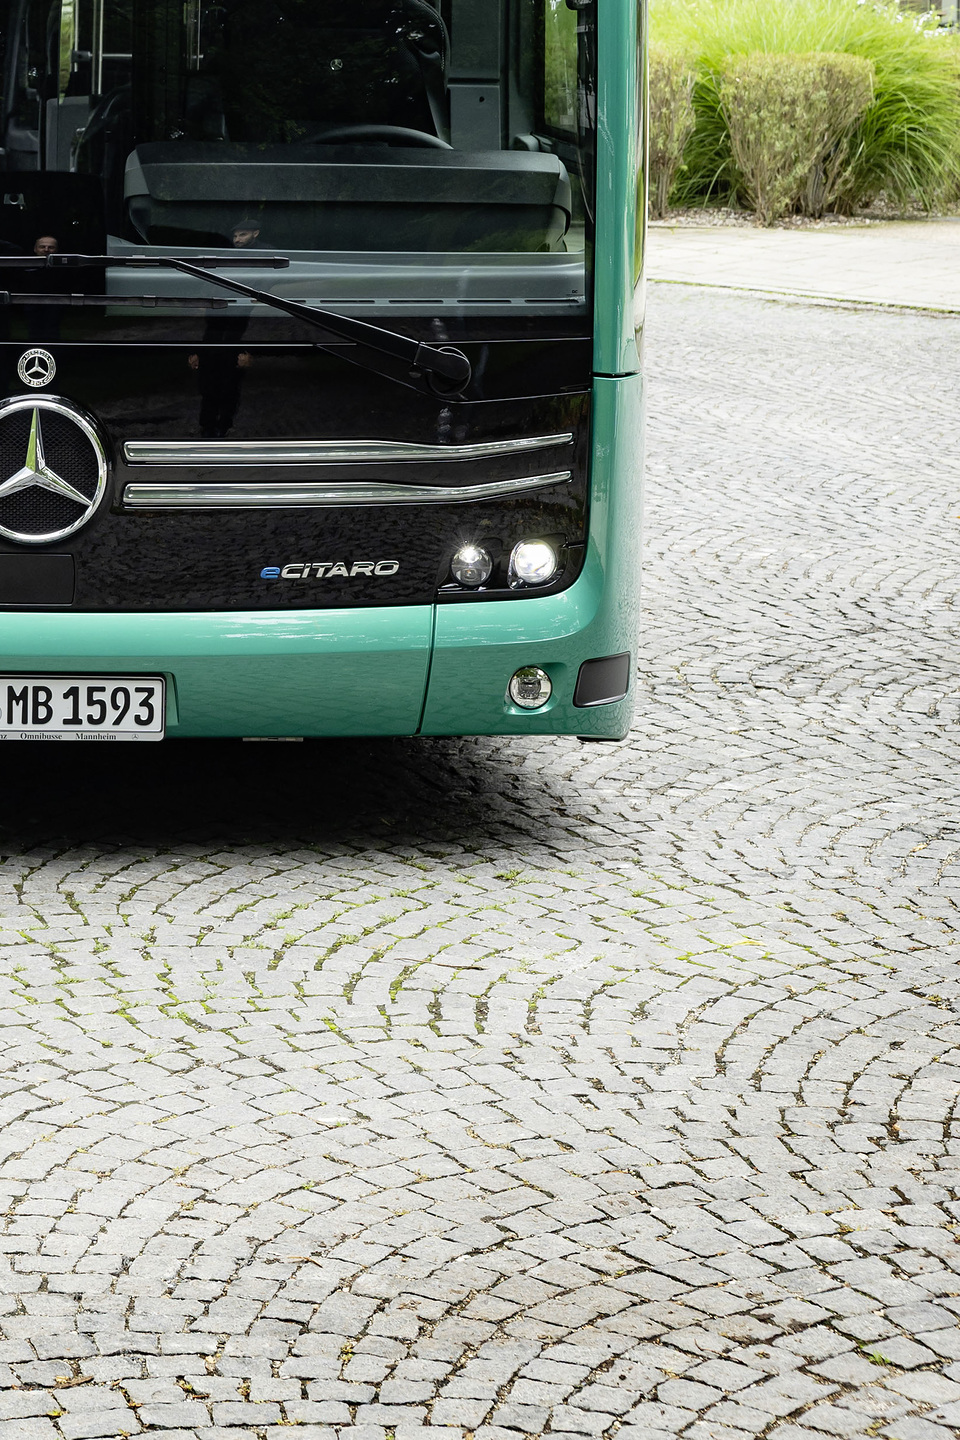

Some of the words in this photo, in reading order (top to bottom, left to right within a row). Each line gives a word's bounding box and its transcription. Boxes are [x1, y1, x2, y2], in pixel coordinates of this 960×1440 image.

[260, 560, 400, 579] eCITARO
[6, 685, 53, 725] MB
[62, 686, 155, 726] 1593
[20, 732, 63, 740] Omnibusse
[75, 732, 117, 740] Mannheim
